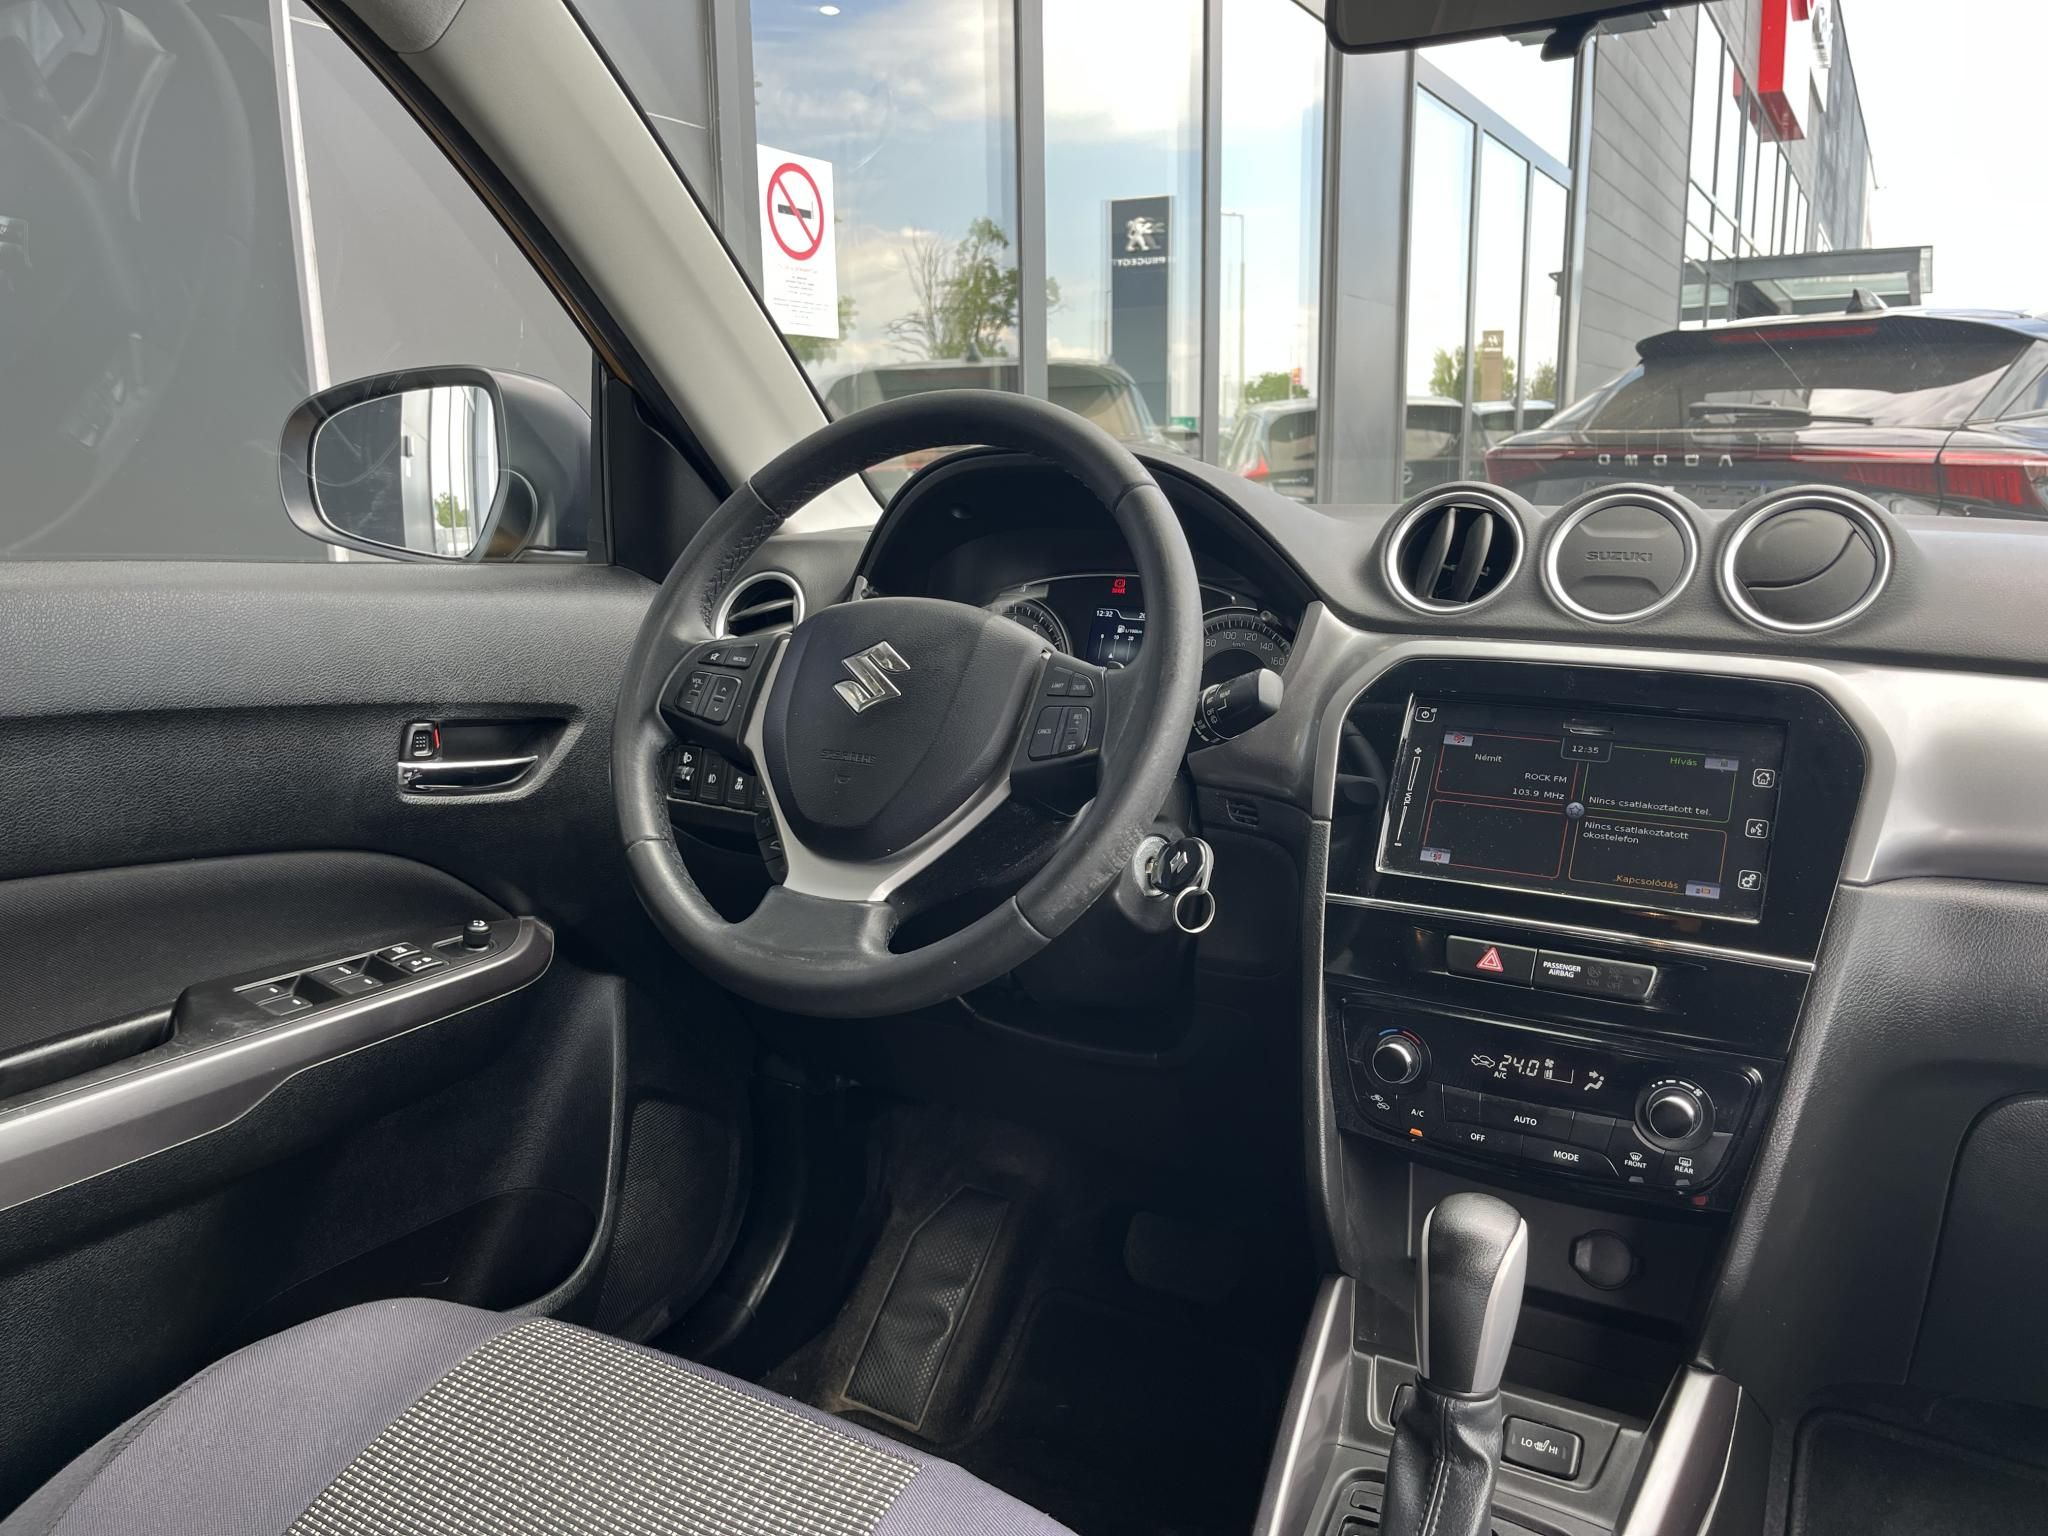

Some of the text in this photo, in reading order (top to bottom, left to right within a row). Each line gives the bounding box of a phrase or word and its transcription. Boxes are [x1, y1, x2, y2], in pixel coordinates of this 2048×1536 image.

[1598, 454, 1733, 467] OMODA
[1585, 551, 1653, 563] SUZUKI
[1096, 610, 1113, 618] 12:32
[1032, 624, 1039, 633] 5
[1222, 631, 1237, 640] 100
[1244, 632, 1258, 641] 120
[1205, 639, 1217, 648] 80
[1260, 642, 1274, 651] 140
[1271, 656, 1285, 666] 160
[1572, 745, 1599, 754] 12:35
[1669, 757, 1698, 767] Hívás
[1524, 772, 1567, 783] ROCK FM
[1403, 791, 1413, 806] VOL
[1513, 787, 1565, 800] 103.9 MHz
[1589, 796, 1712, 816] Nincs csatlakoztatott tel.
[1584, 821, 1689, 840] Nincs csatlakoztatott
[1583, 831, 1639, 844] okostelefon
[1543, 961, 1581, 973] PASSENGER
[1548, 968, 1575, 978] AIRBAG
[1498, 1054, 1540, 1077] 24.0
[1493, 1070, 1507, 1080] A/C
[1410, 1108, 1424, 1118] A/C
[1513, 1115, 1537, 1126] AUTO
[1470, 1132, 1486, 1142] OFF
[1553, 1150, 1579, 1162] MODE
[1624, 1159, 1647, 1169] FRONT
[1674, 1165, 1694, 1175] REAR
[1521, 1437, 1559, 1455] LO HI
